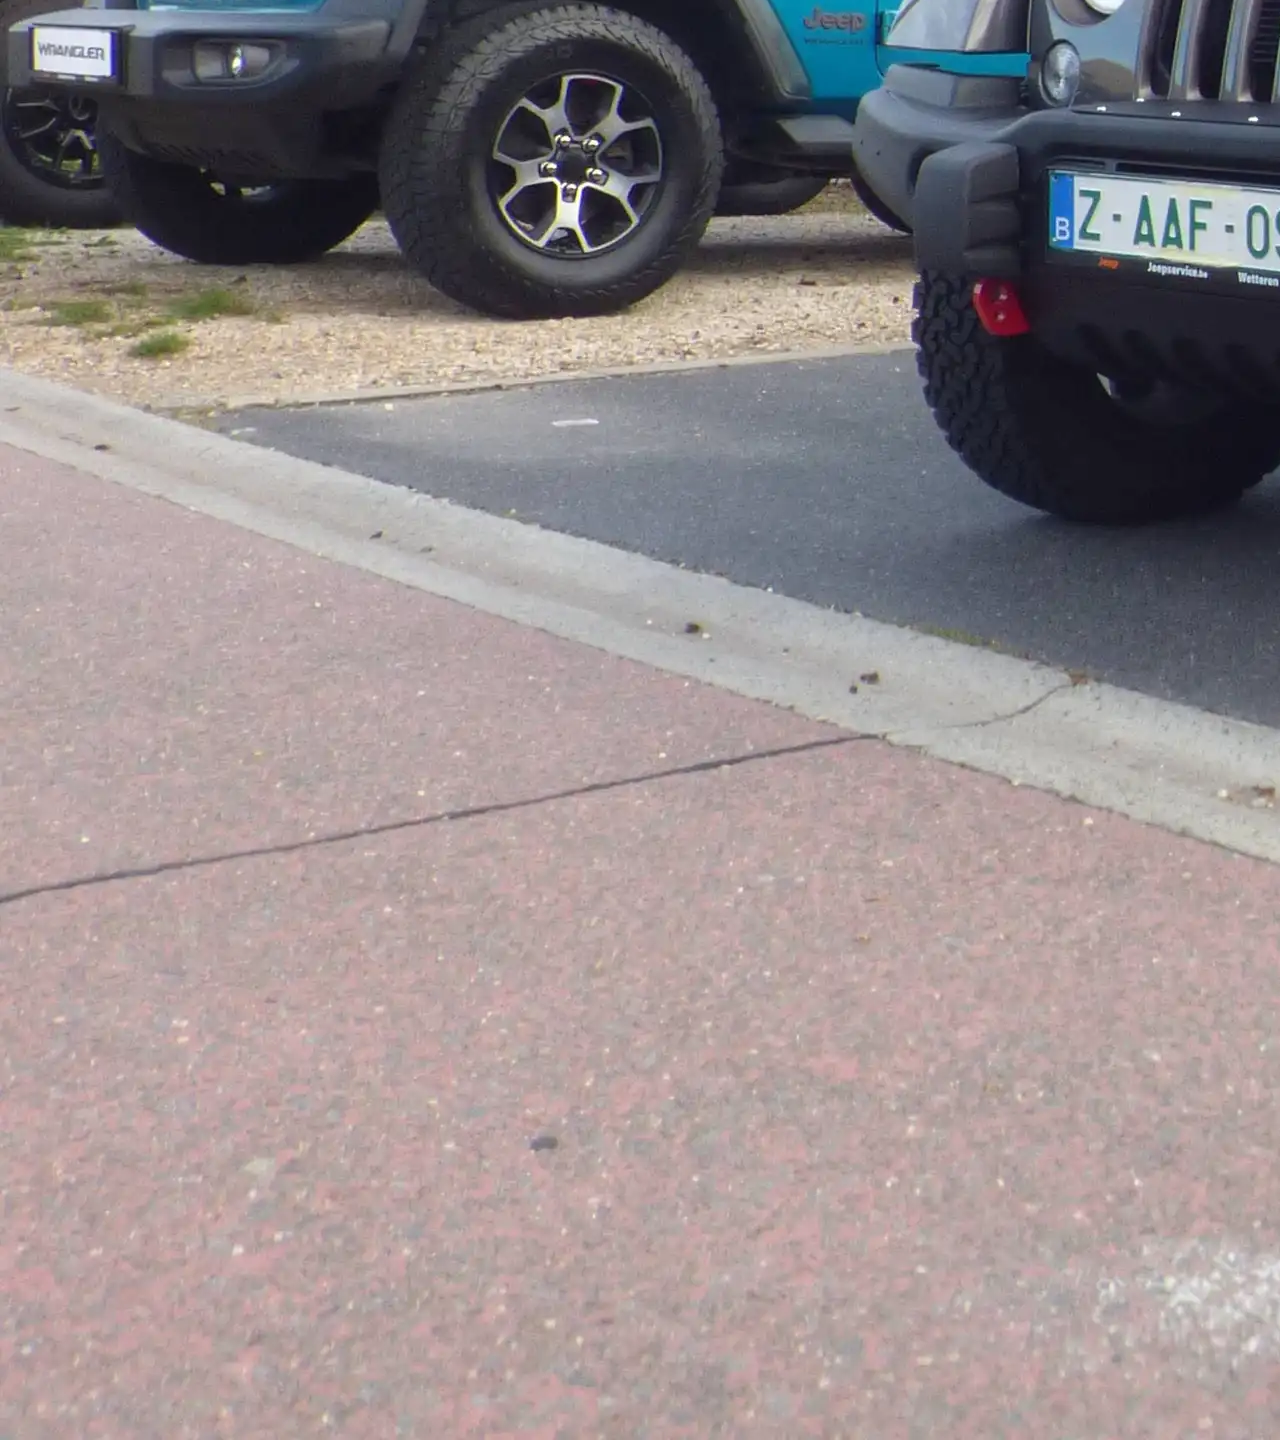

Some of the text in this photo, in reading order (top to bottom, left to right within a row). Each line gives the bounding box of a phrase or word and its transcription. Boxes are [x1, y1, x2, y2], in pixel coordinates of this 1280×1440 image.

[803, 7, 865, 35] Jeep
[37, 42, 105, 61] WRANGLER
[1055, 216, 1070, 241] B
[1238, 271, 1279, 287] Wetteren
